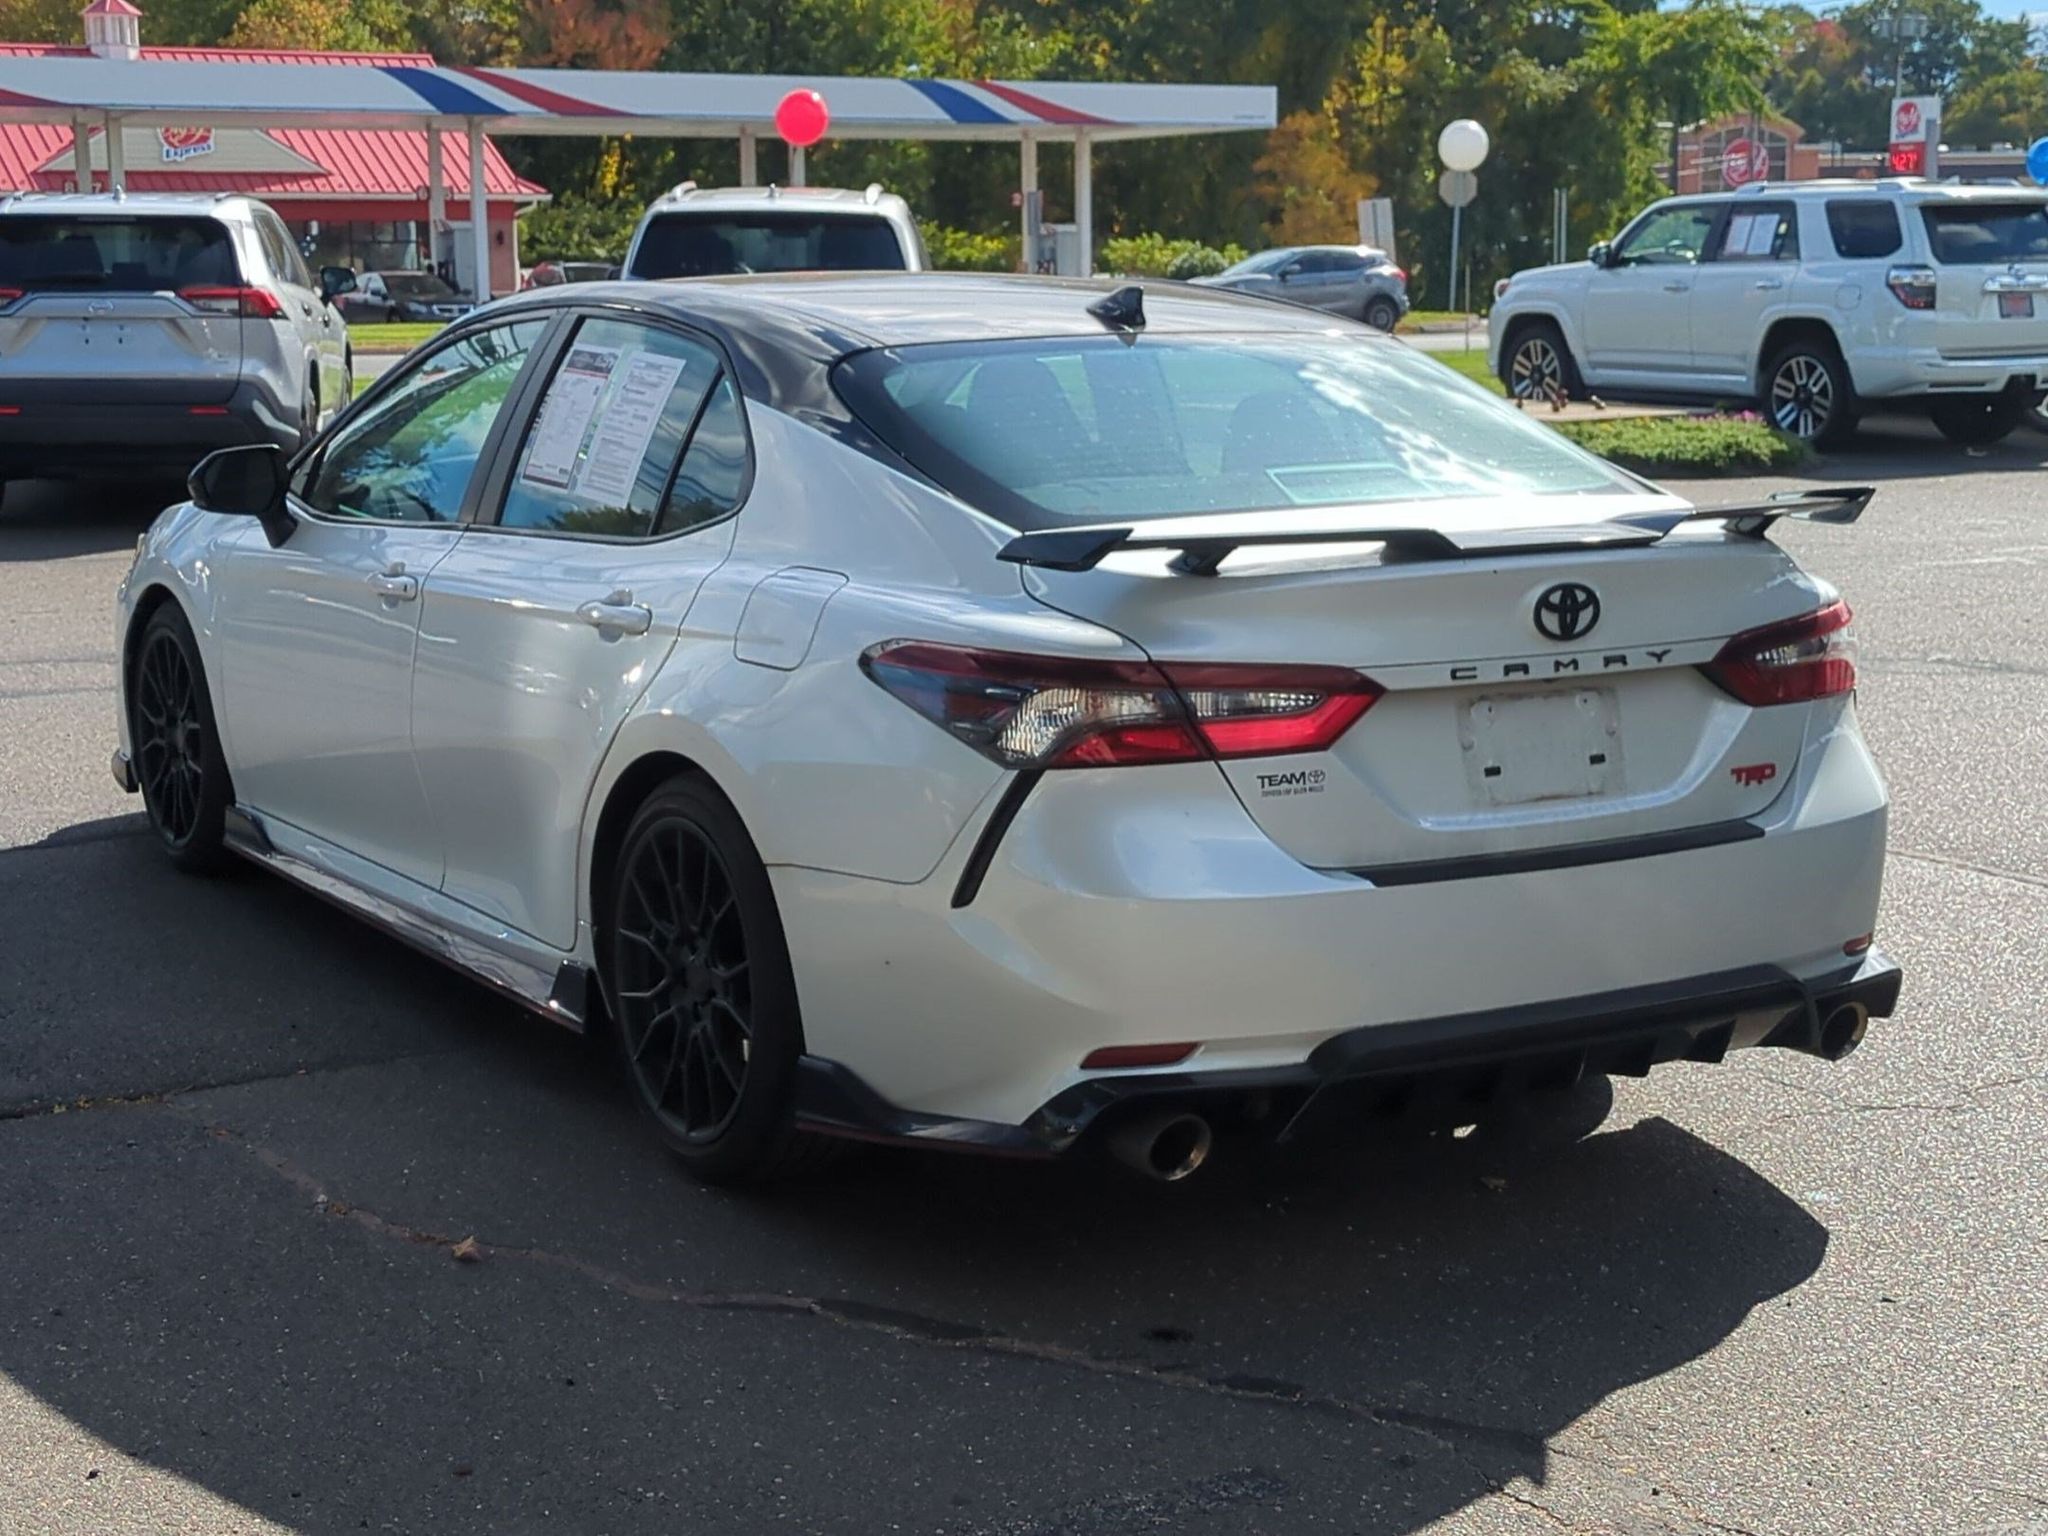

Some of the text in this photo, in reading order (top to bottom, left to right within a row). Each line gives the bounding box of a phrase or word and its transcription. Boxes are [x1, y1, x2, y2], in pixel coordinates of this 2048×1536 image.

[165, 143, 212, 159] Express
[1450, 648, 1672, 680] CAMRY
[1257, 771, 1306, 789] TEAM
[1731, 763, 1776, 786] TRD
